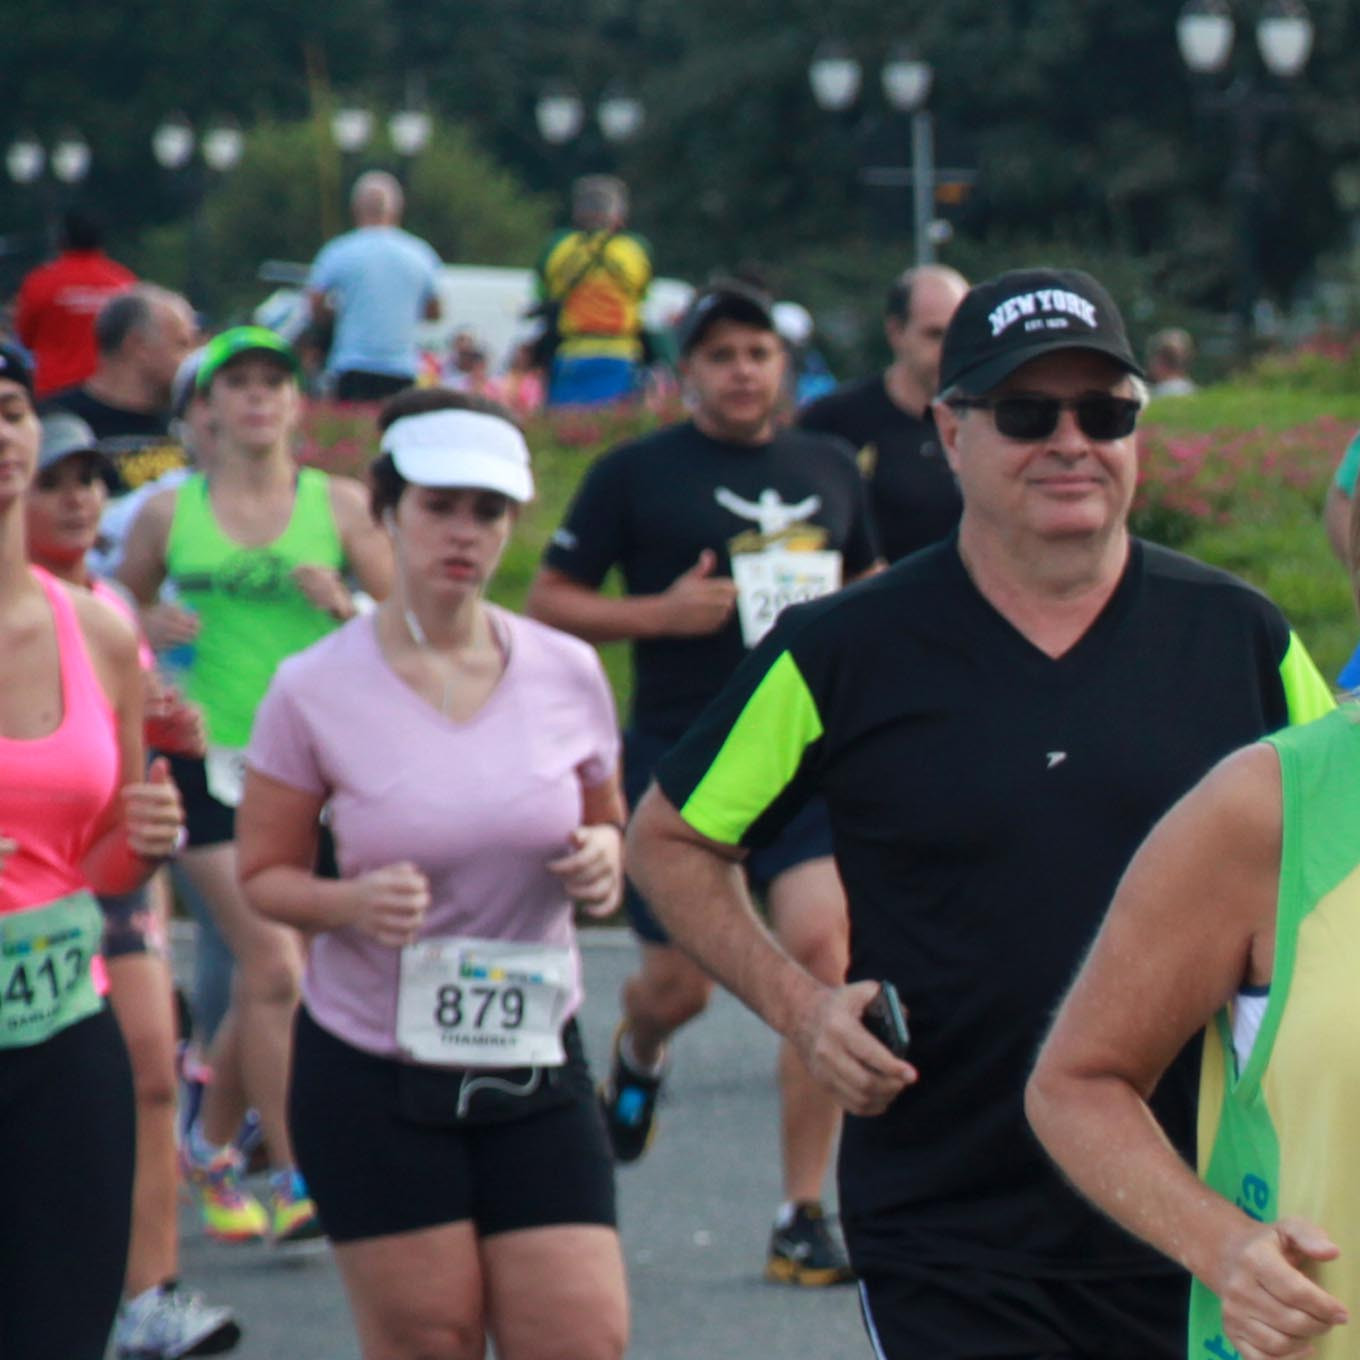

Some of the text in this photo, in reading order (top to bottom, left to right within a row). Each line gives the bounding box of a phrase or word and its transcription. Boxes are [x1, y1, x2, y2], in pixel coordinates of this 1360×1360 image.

[988, 289, 1097, 336] NEW YORK
[435, 983, 524, 1030] 879
